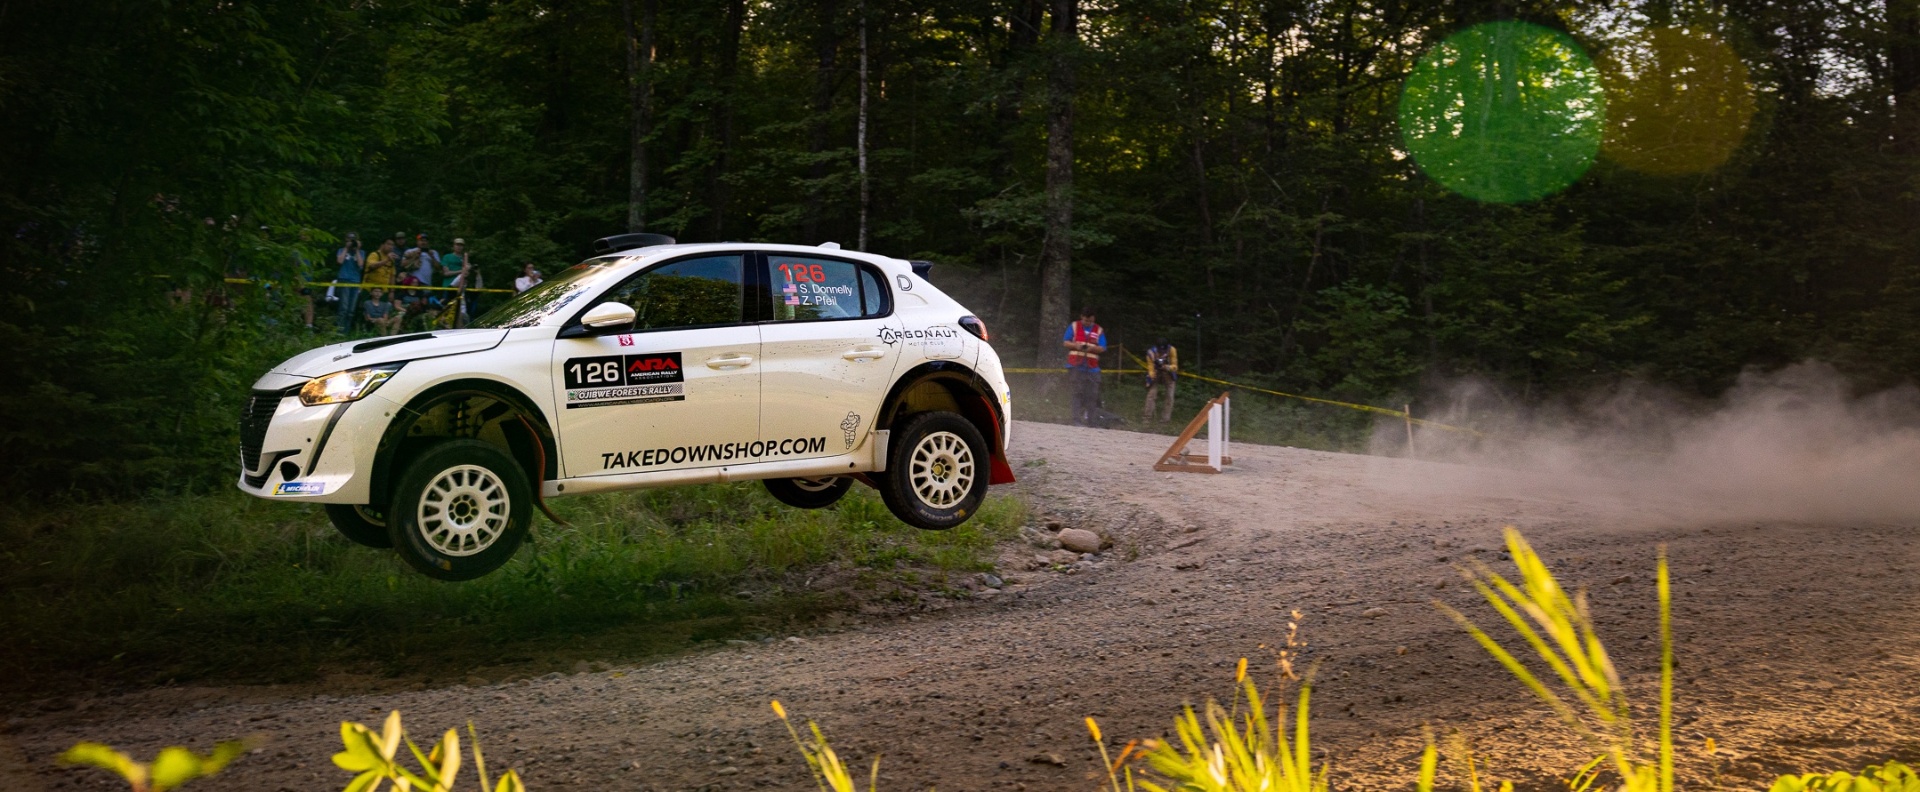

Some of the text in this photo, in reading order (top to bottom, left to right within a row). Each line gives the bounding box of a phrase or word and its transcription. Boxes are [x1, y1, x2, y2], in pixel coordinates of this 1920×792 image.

[778, 263, 826, 283] 126
[799, 283, 853, 297] S. Donnelly
[801, 295, 837, 306] Z. Pfeil
[884, 329, 958, 341] ARGONAUT
[628, 358, 680, 372] ARA
[569, 361, 620, 384] 126
[578, 386, 673, 400] OJIBWE FORESTS RALLY
[601, 437, 827, 469] TAKEDOWNSHOP.COM
